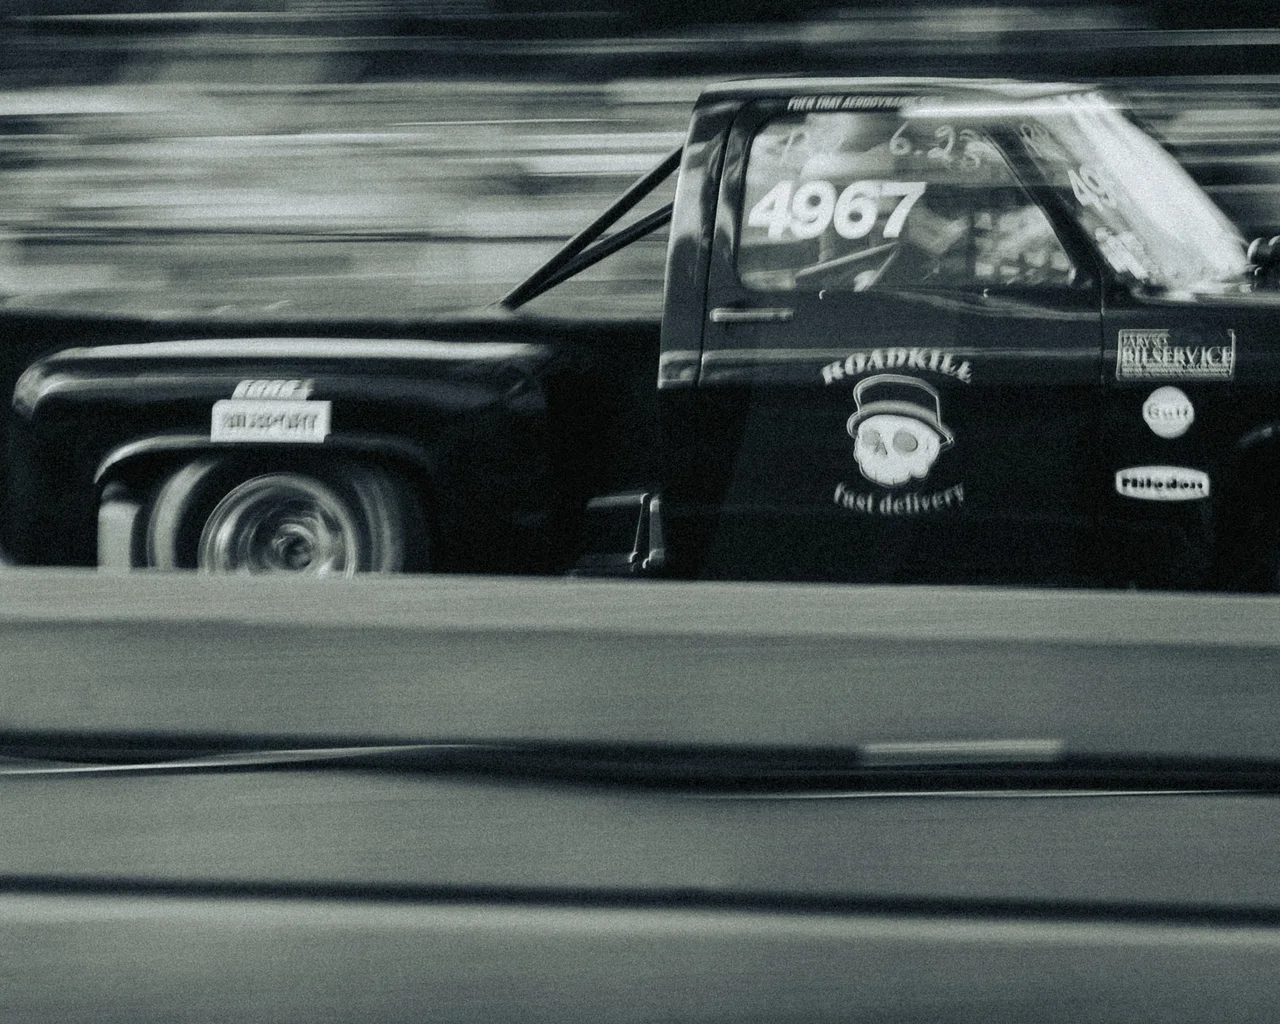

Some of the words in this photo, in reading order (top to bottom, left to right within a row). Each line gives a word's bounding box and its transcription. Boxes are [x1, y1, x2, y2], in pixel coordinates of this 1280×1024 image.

[748, 180, 927, 240] 4967
[821, 347, 973, 385] ROADKILL
[1121, 346, 1233, 366] BILSERVICE
